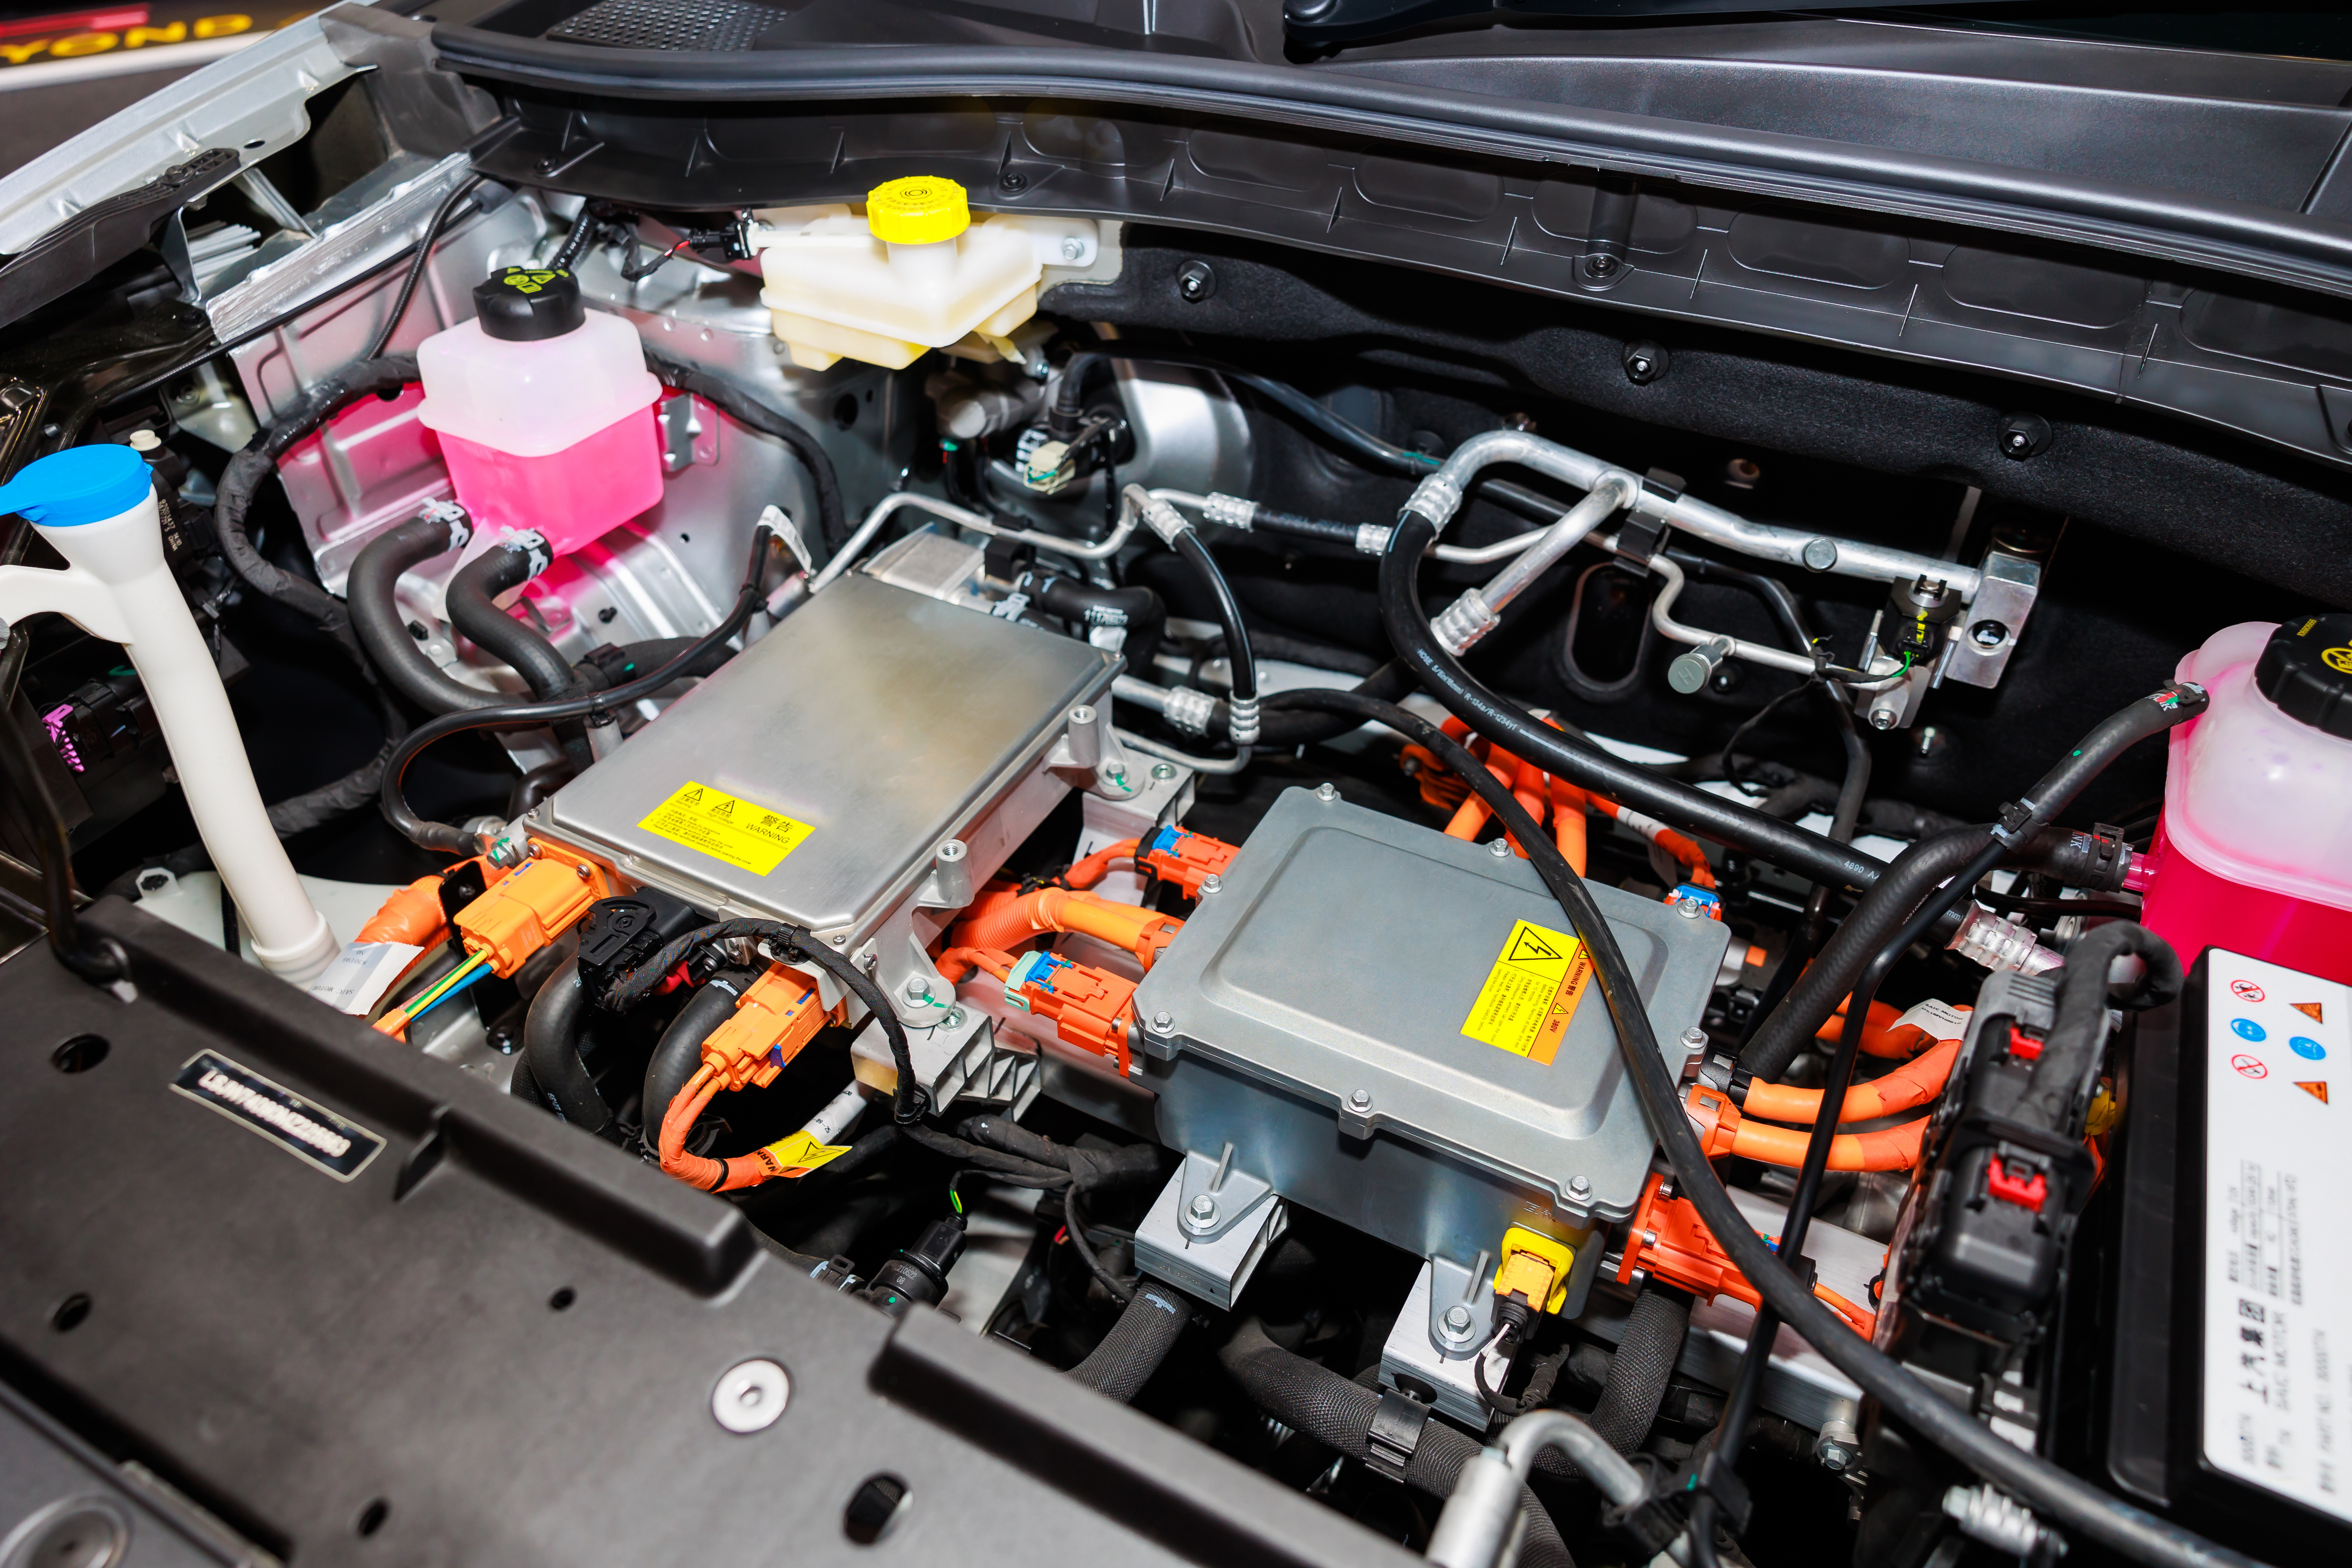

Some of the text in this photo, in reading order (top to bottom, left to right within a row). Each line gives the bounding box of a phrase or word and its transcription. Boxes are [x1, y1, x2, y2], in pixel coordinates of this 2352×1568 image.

[1417, 648, 1433, 666] HOSE
[674, 799, 693, 808] Warning
[761, 815, 795, 833] 警告
[745, 823, 790, 844] WARNING
[1844, 860, 1864, 873] 4890
[1501, 970, 1510, 981] Please
[1565, 962, 1587, 996] WARNING 警告
[1509, 983, 1522, 1001] professional
[1539, 983, 1547, 994] Before
[1488, 992, 1498, 1008] handbook
[1924, 1003, 1940, 1011] SAIC
[1480, 1007, 1491, 1021] carefully
[1503, 1001, 1513, 1014] workers
[1526, 1007, 1536, 1020] Remove
[1476, 1020, 1485, 1032] before
[1550, 1019, 1560, 1033] 380V
[896, 1265, 918, 1280] 210622
[896, 1275, 906, 1285] 08
[2272, 1310, 2288, 1368] MOTOR
[2236, 1296, 2268, 1404] 上汽集团
